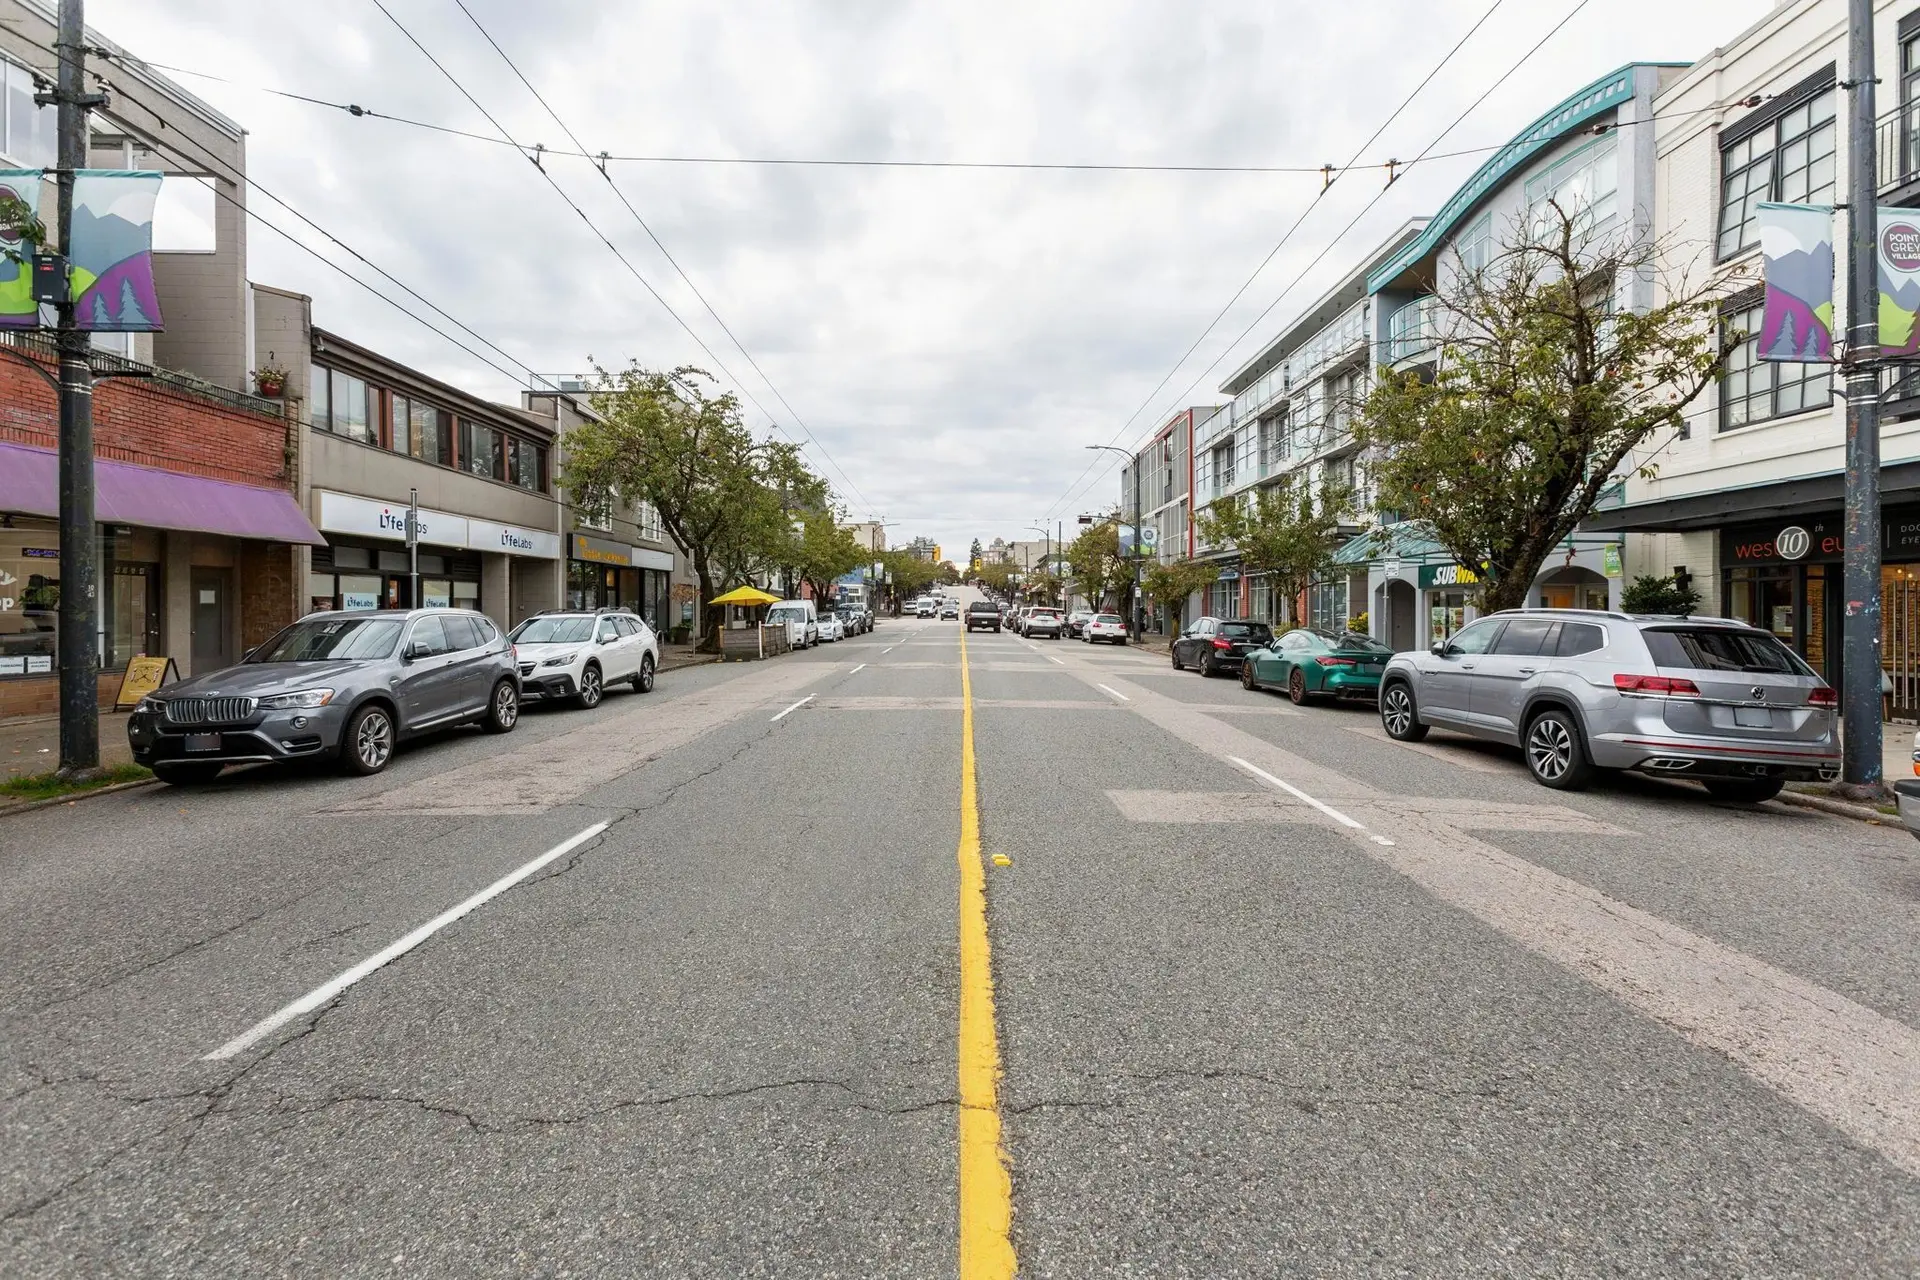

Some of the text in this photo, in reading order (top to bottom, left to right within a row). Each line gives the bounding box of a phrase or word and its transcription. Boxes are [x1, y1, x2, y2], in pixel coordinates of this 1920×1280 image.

[1889, 233, 1919, 242] POINT
[1890, 242, 1920, 252] GREY
[501, 529, 533, 549] LifeLabs
[1782, 532, 1806, 554] 10
[1432, 561, 1488, 586] SUBWA
[347, 596, 374, 607] LifeLabs
